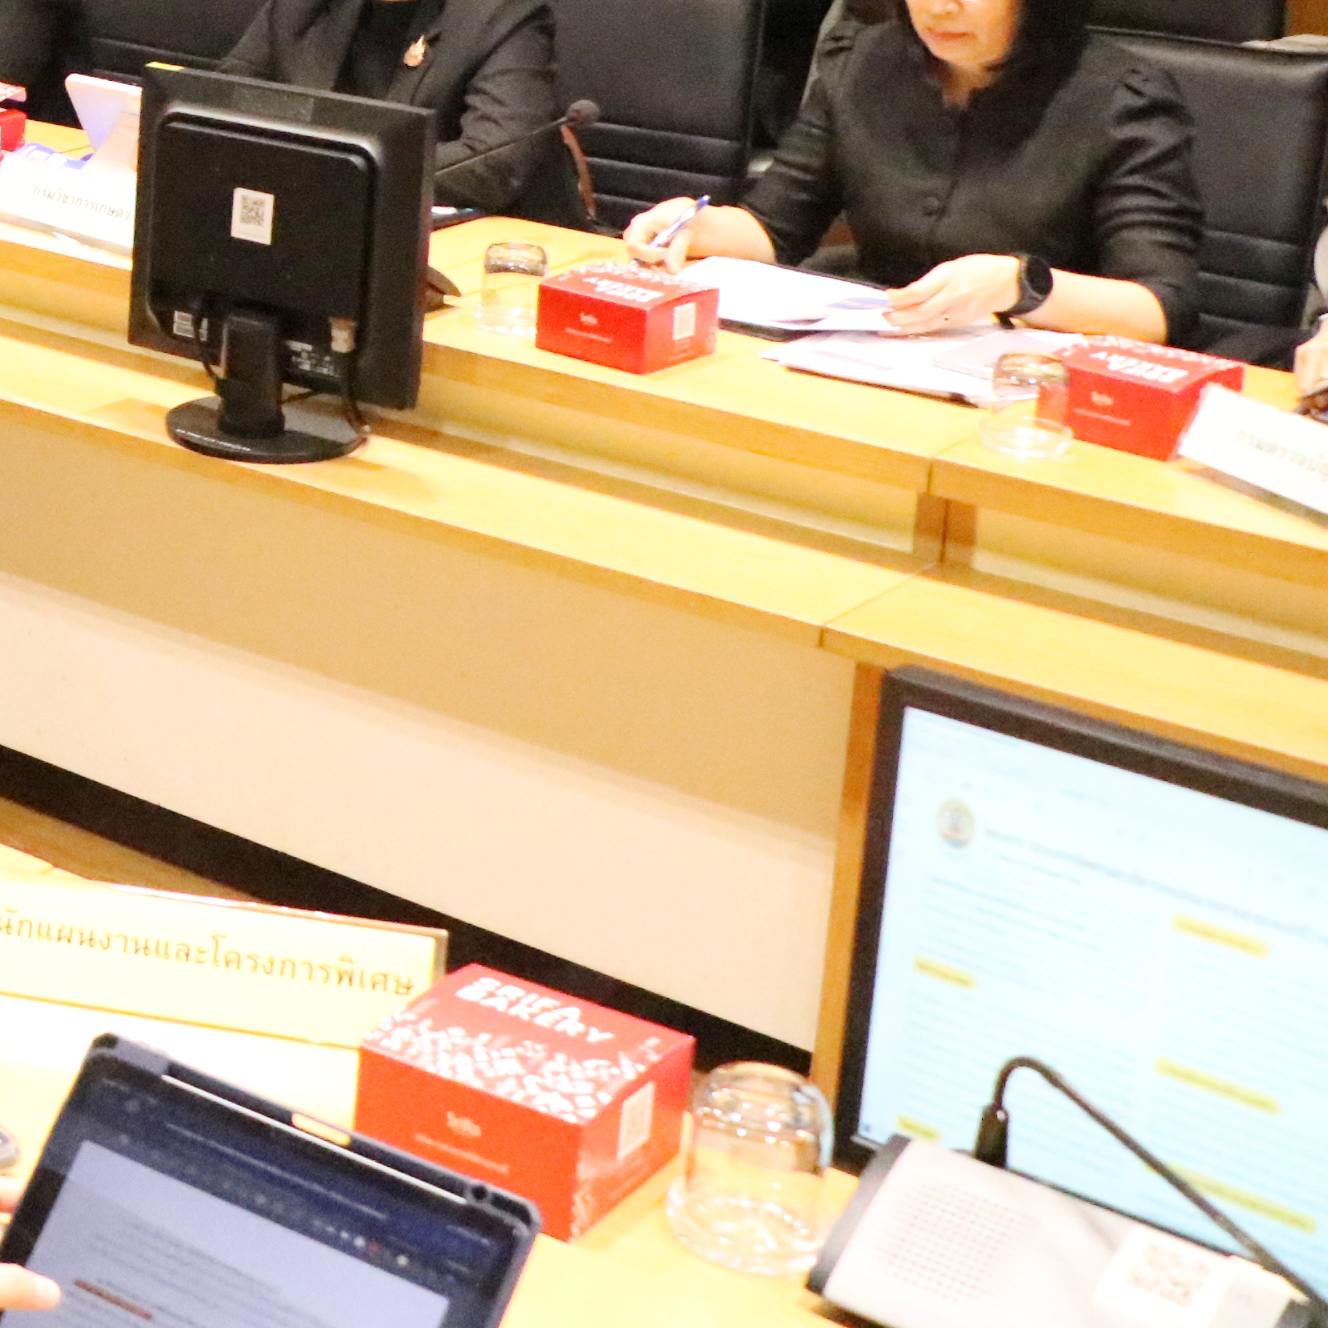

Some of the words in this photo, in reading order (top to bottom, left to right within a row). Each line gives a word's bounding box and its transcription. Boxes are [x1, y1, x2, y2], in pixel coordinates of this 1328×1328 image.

[32, 184, 132, 221] กรมวิชาการเกษตร
[455, 984, 616, 1043] BAKERY
